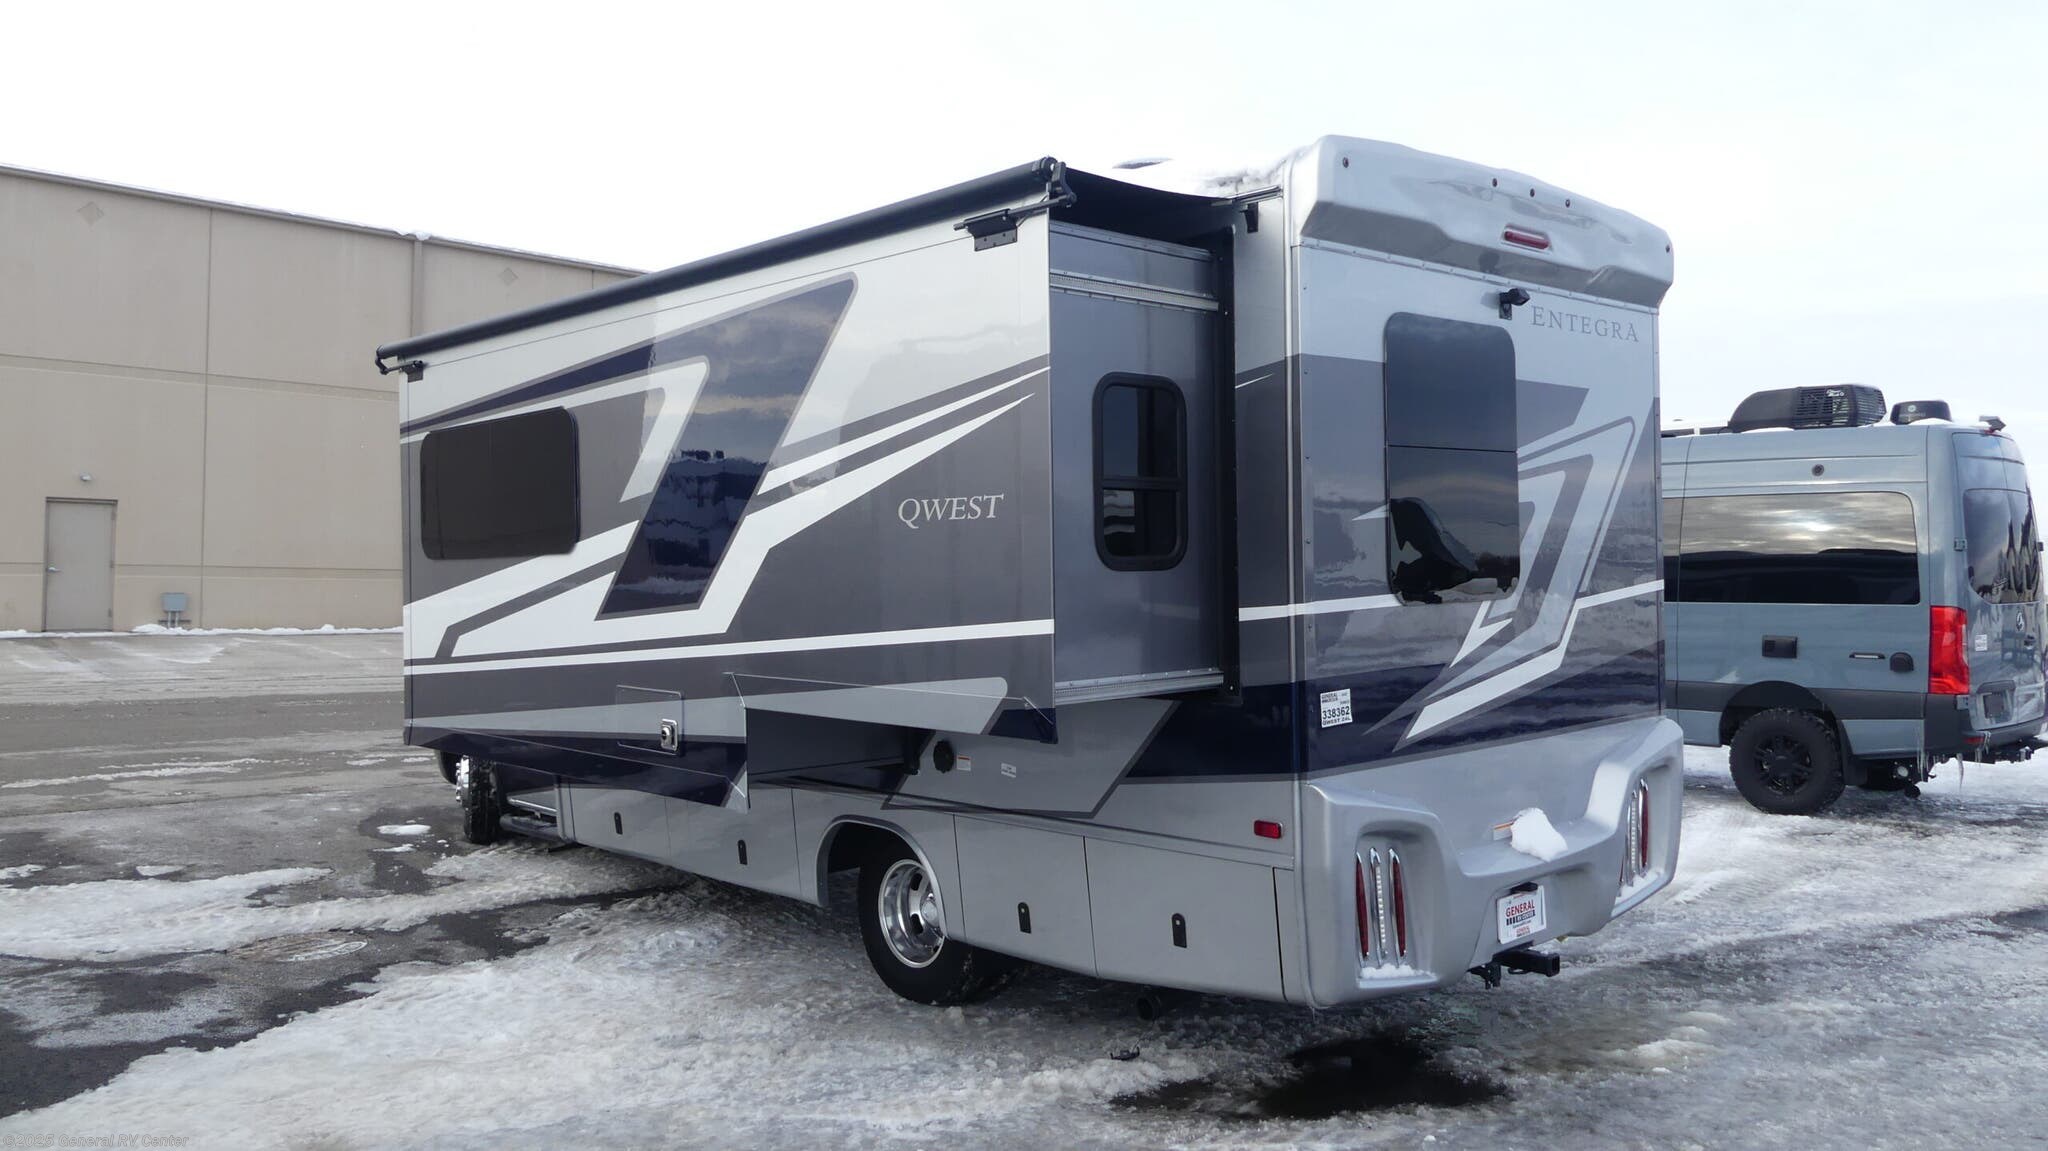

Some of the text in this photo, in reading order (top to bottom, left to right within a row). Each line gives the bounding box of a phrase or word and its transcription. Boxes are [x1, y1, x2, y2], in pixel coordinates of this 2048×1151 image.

[1531, 305, 1639, 342] ENTEGRA
[898, 493, 1004, 529] QWEST
[1322, 706, 1350, 719] 338362
[1505, 899, 1535, 917] GENERAL
